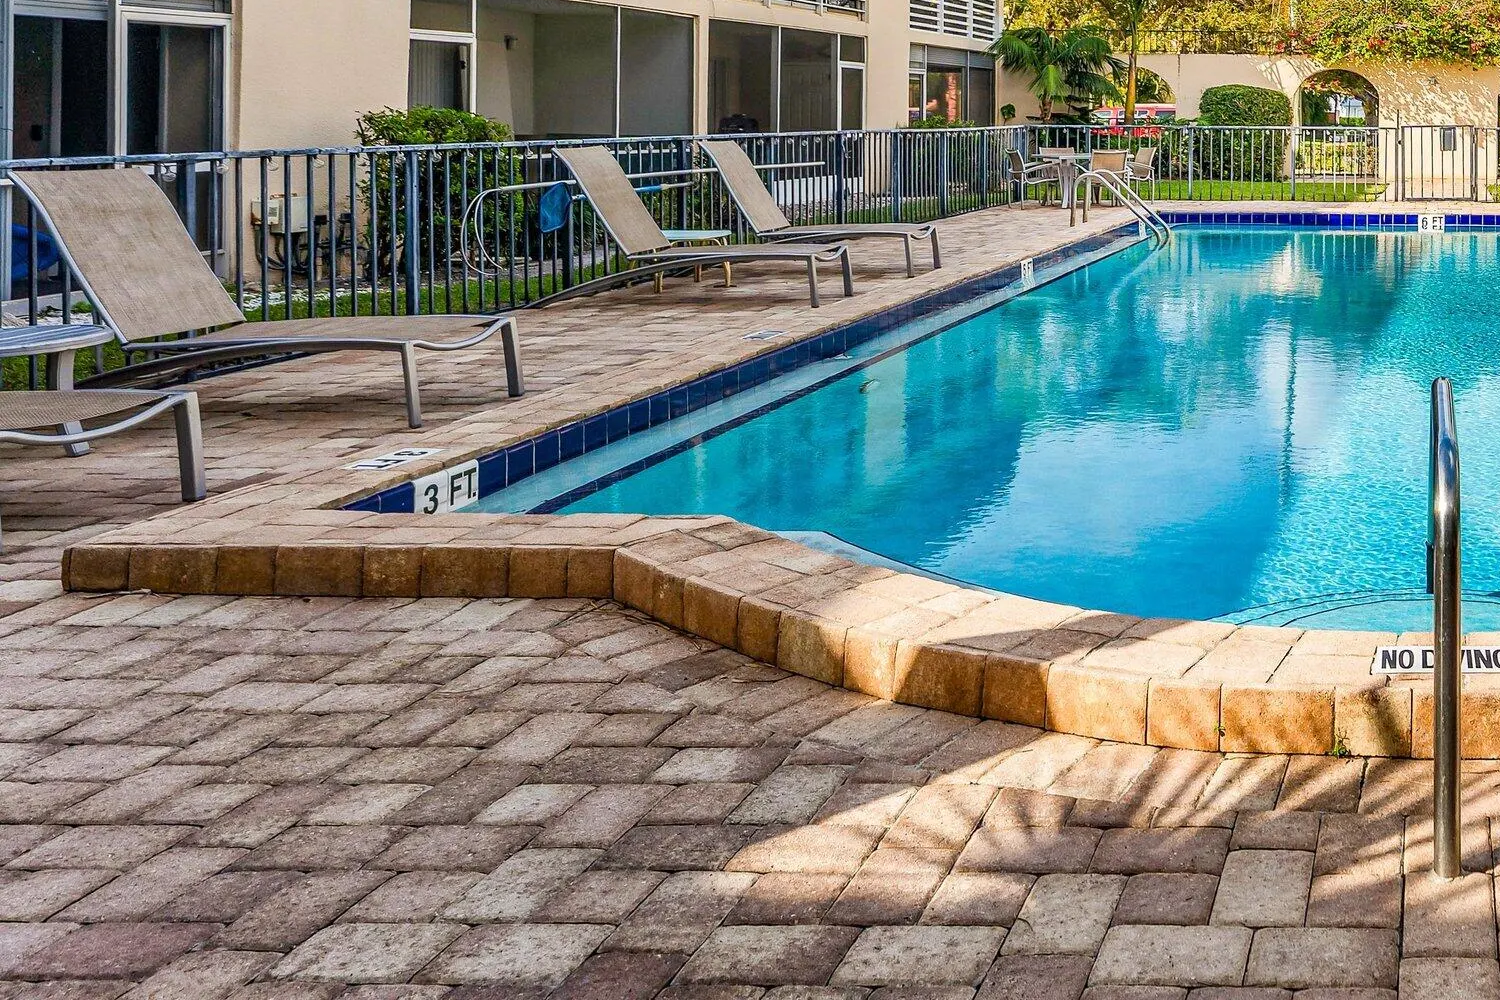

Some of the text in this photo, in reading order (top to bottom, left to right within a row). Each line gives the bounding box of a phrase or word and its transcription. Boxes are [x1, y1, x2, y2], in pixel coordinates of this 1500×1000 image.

[1432, 216, 1443, 226] FT
[424, 484, 439, 514] 3
[1381, 649, 1415, 669] NO
